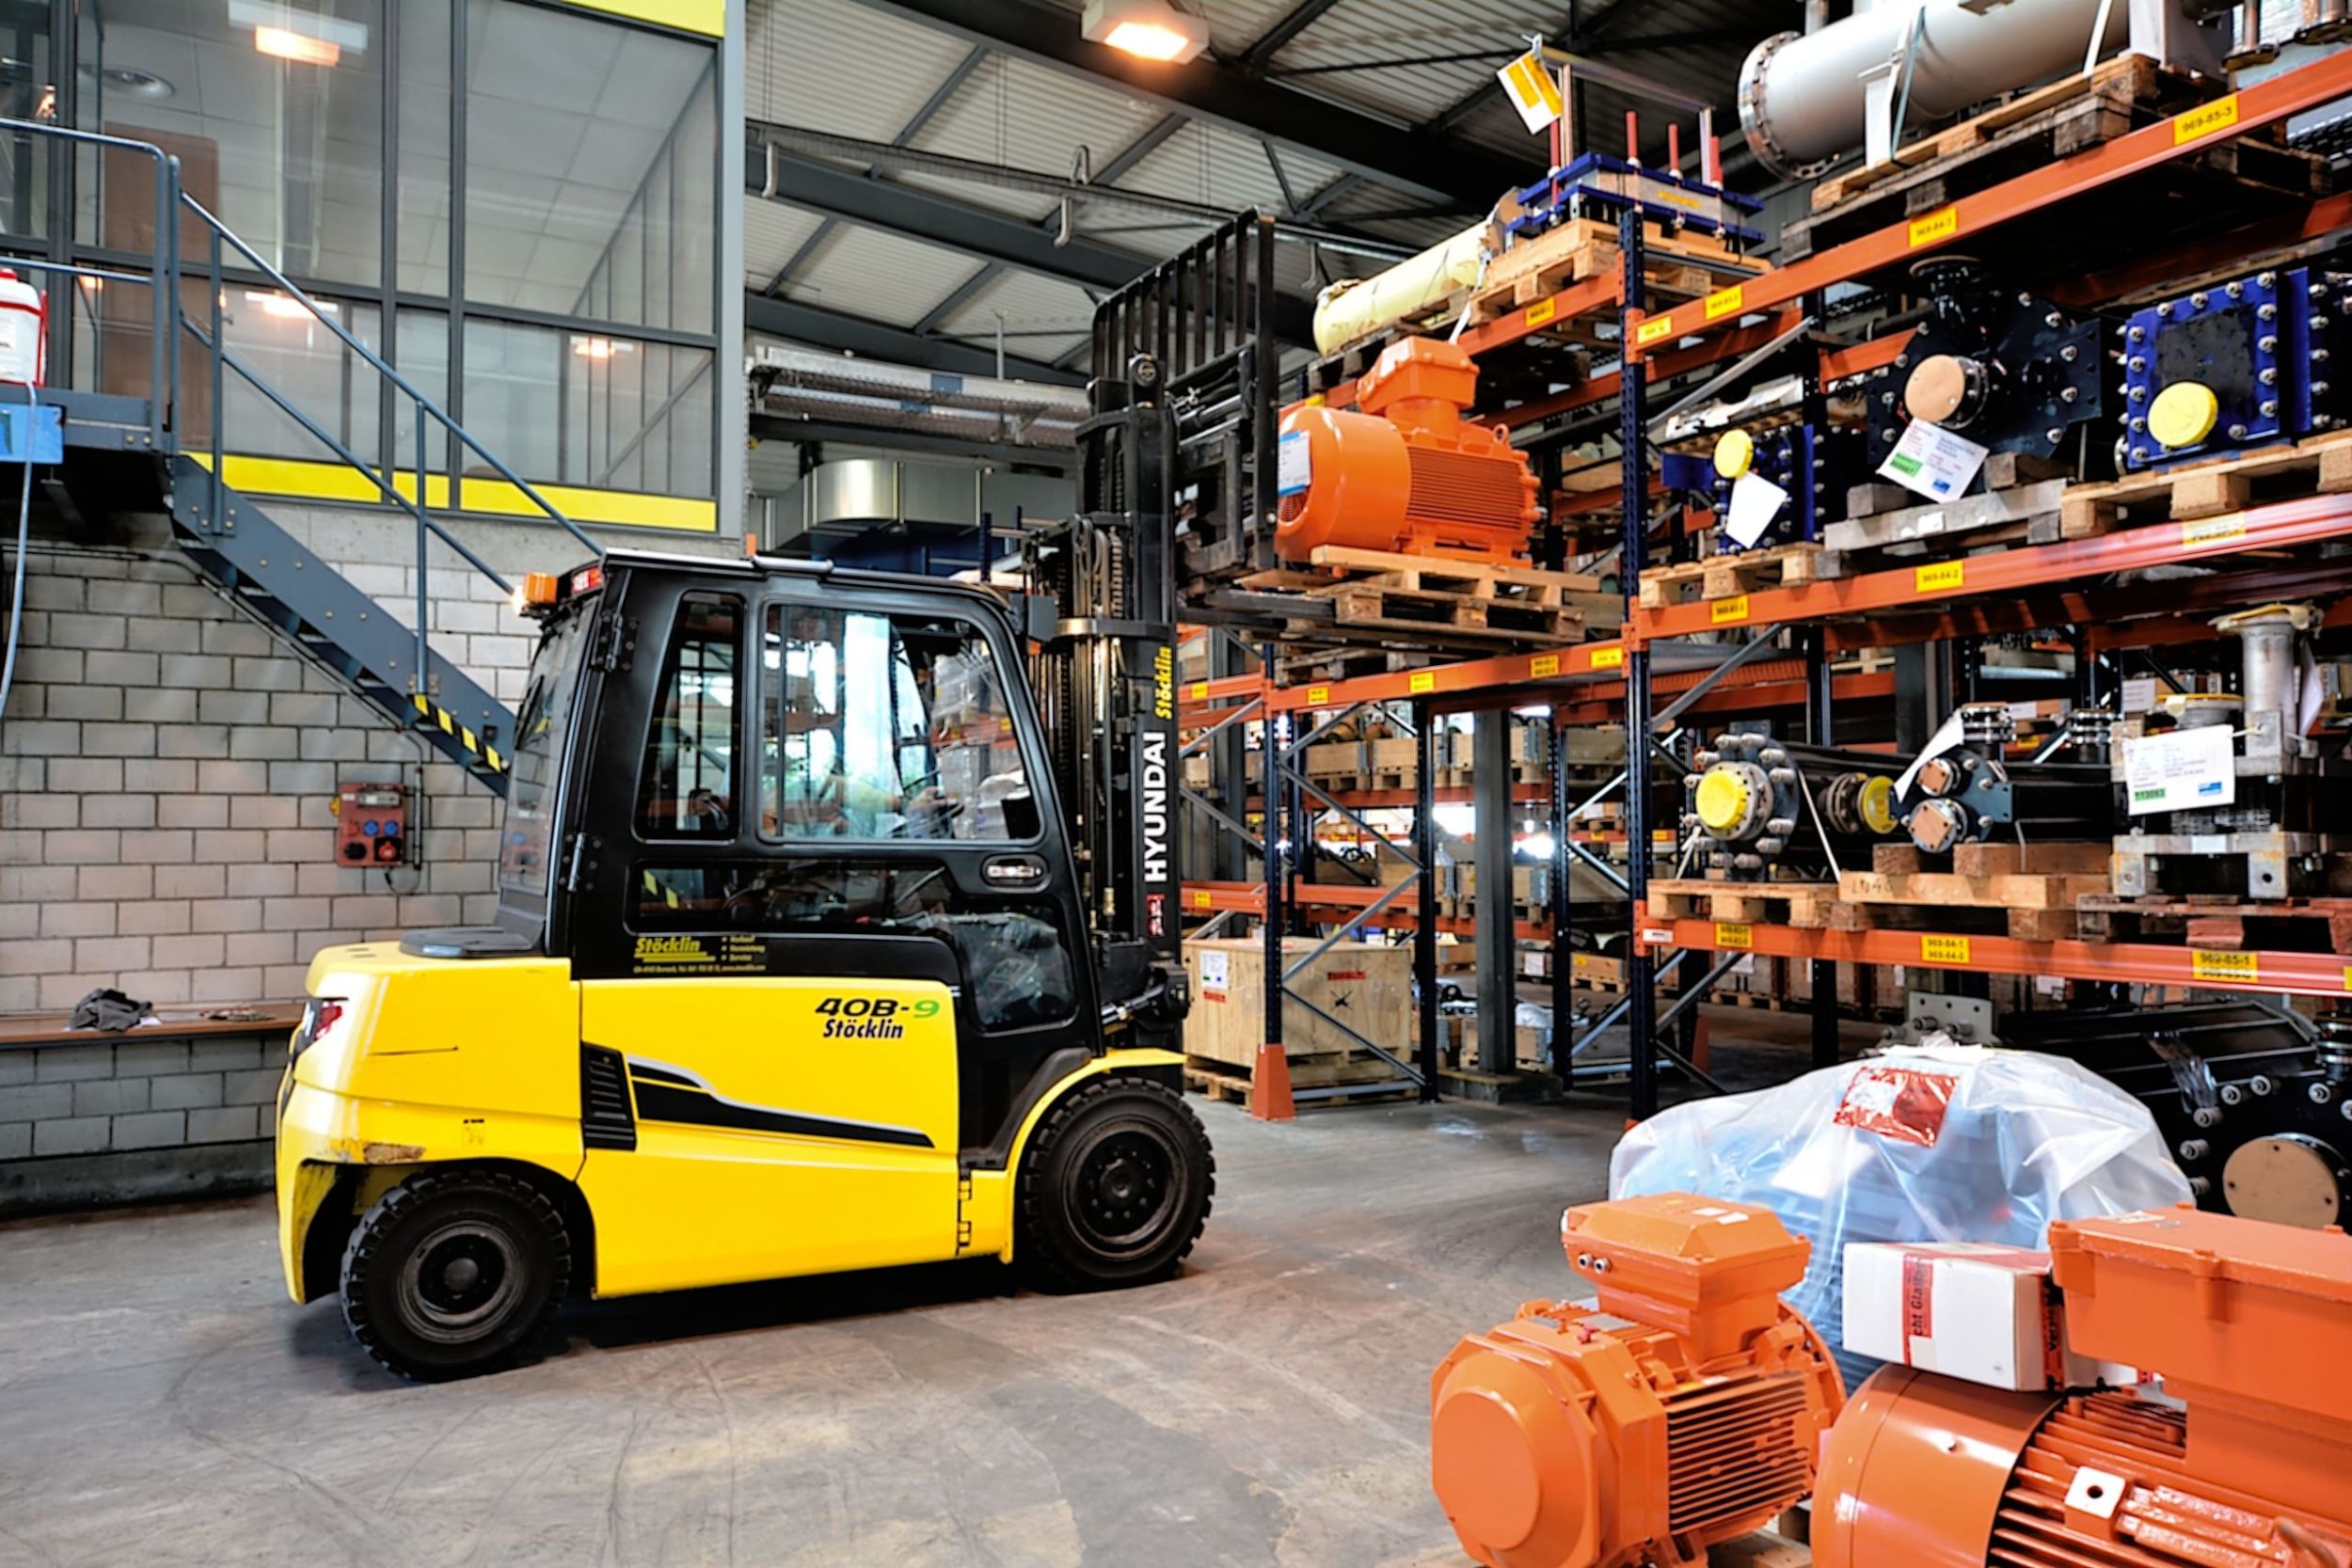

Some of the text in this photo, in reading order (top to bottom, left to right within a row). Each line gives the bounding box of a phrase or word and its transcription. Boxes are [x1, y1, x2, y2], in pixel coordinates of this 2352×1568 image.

[1155, 647, 1173, 719] Stöcklin
[1143, 732, 1168, 882] HYUNDAI
[634, 936, 702, 953] Stöcklin
[815, 998, 940, 1018] 40B-9
[822, 1018, 904, 1039] Stöcklin
